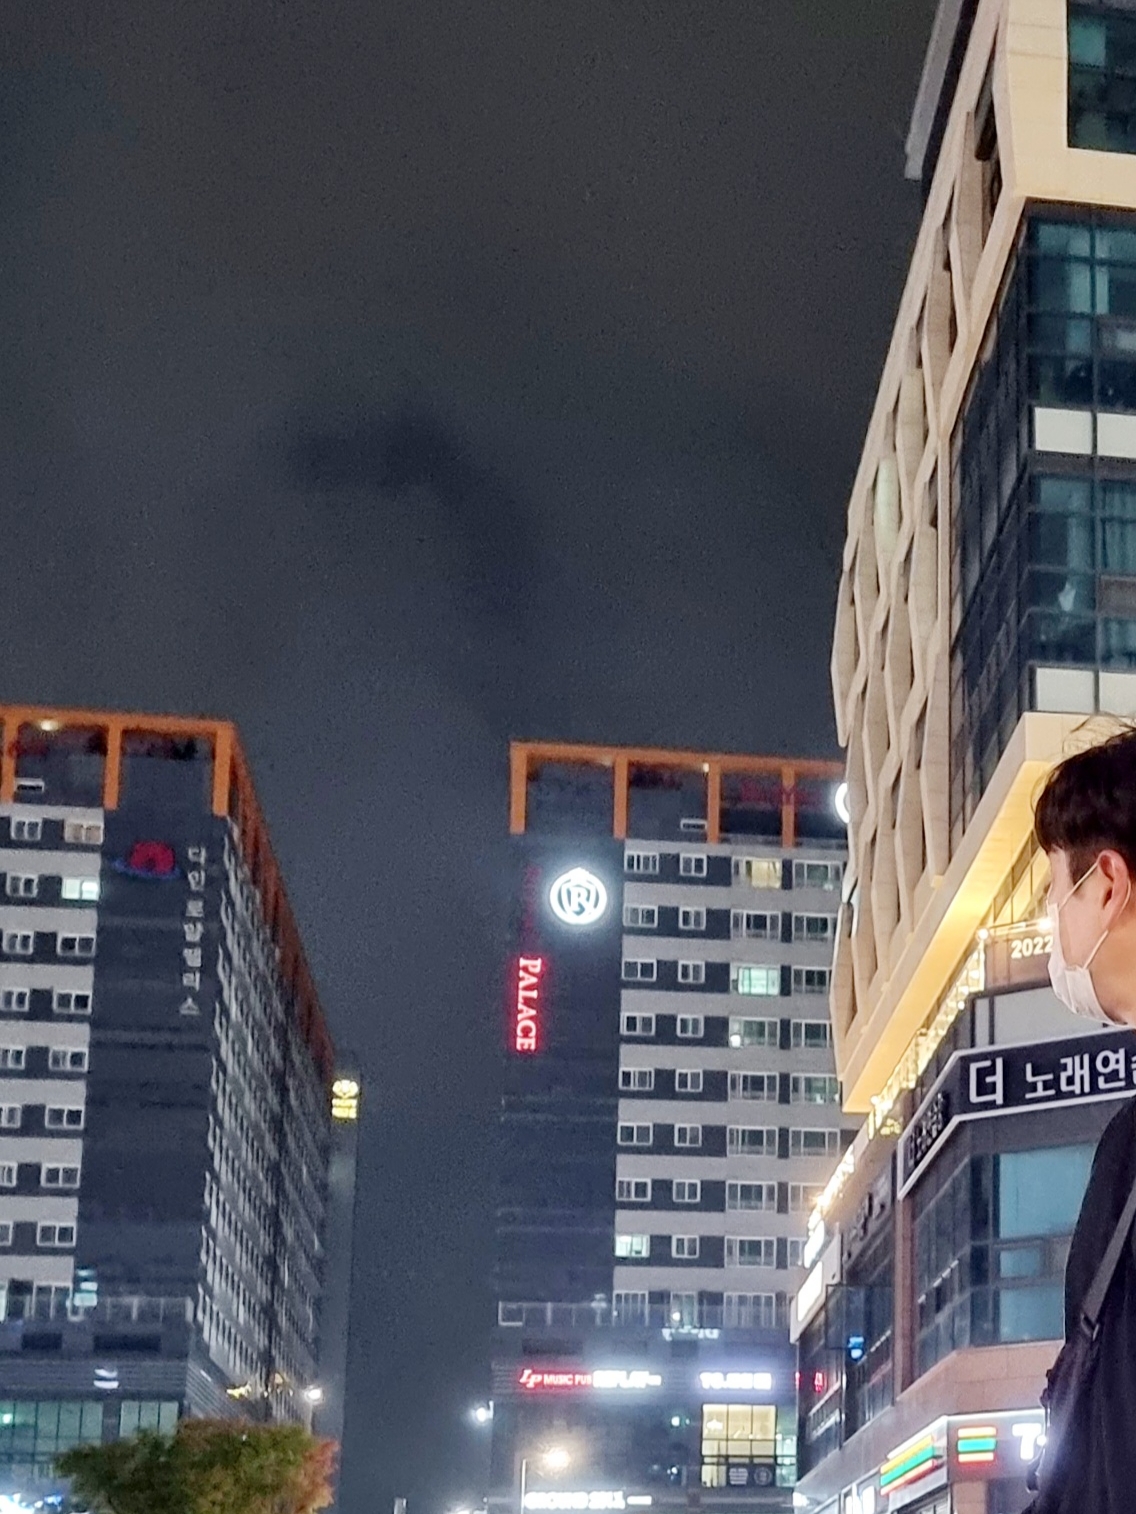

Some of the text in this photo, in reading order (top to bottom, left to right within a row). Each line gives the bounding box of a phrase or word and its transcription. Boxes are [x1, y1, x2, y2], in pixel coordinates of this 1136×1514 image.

[515, 956, 543, 1052] PALACE
[969, 1056, 1004, 1106] 더
[543, 1373, 574, 1387] MUSIC
